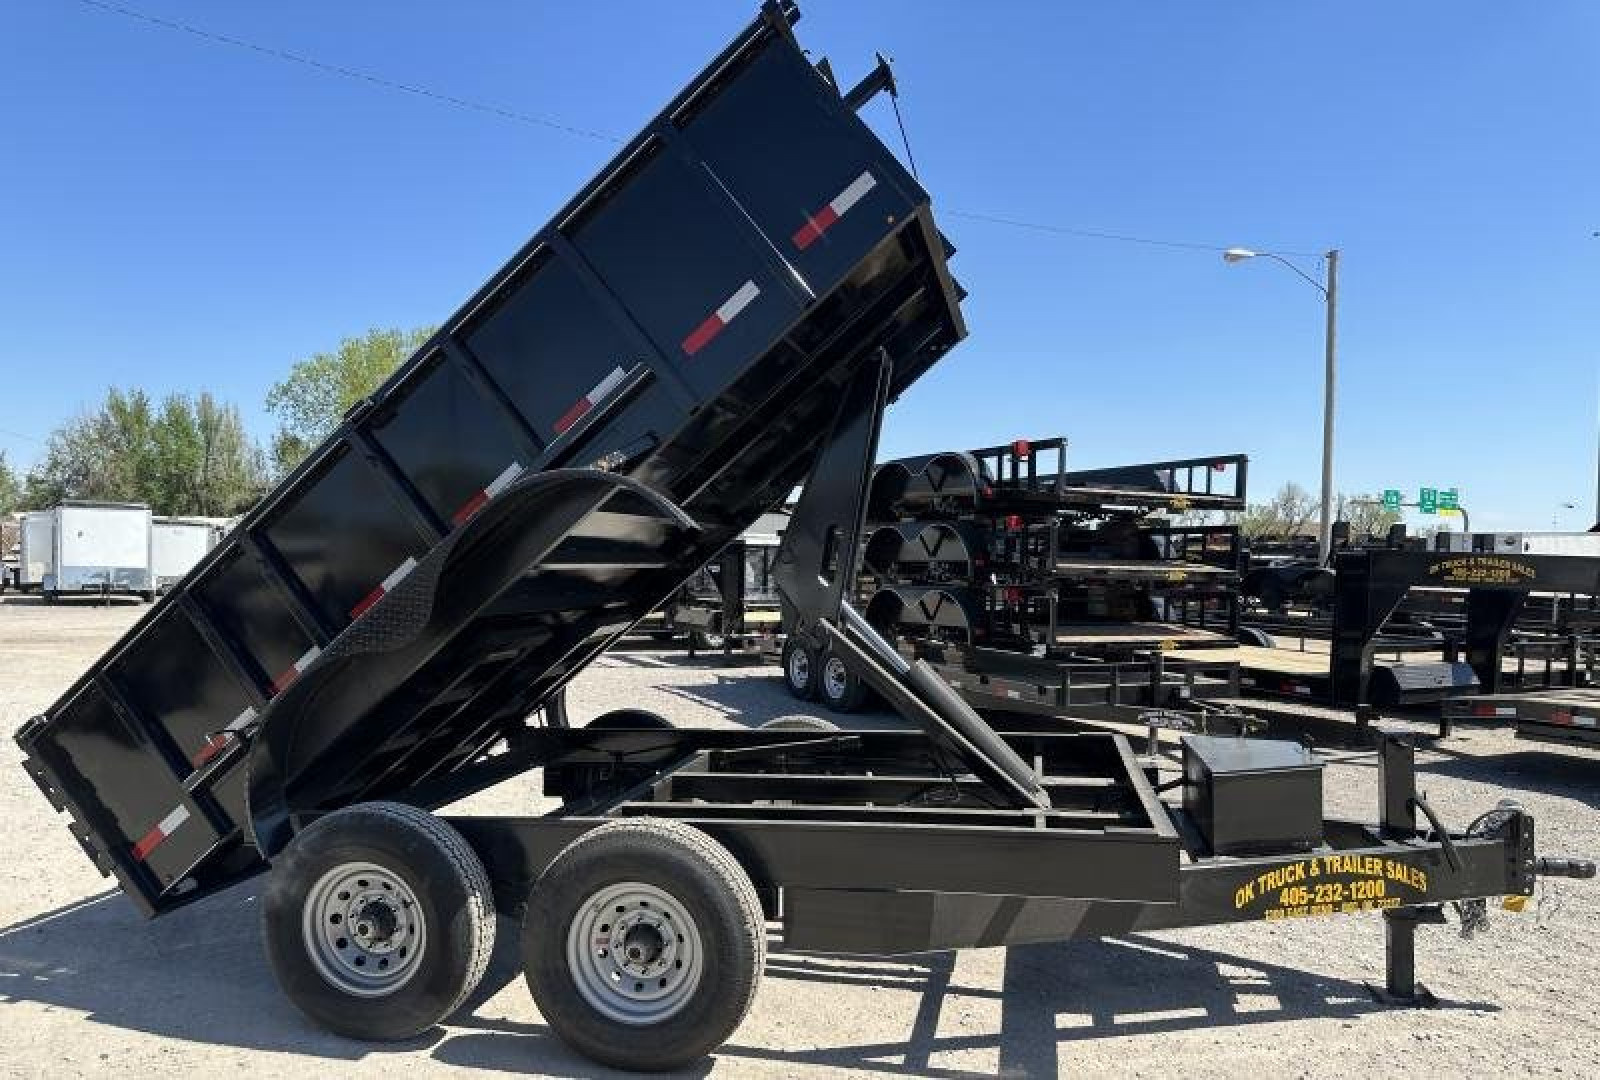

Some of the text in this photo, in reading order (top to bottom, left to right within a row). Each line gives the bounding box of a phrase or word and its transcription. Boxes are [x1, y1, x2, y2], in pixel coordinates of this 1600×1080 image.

[1235, 855, 1427, 908] OK TRUCK & TRAILER SALES
[1279, 879, 1385, 907] 405-232-1200
